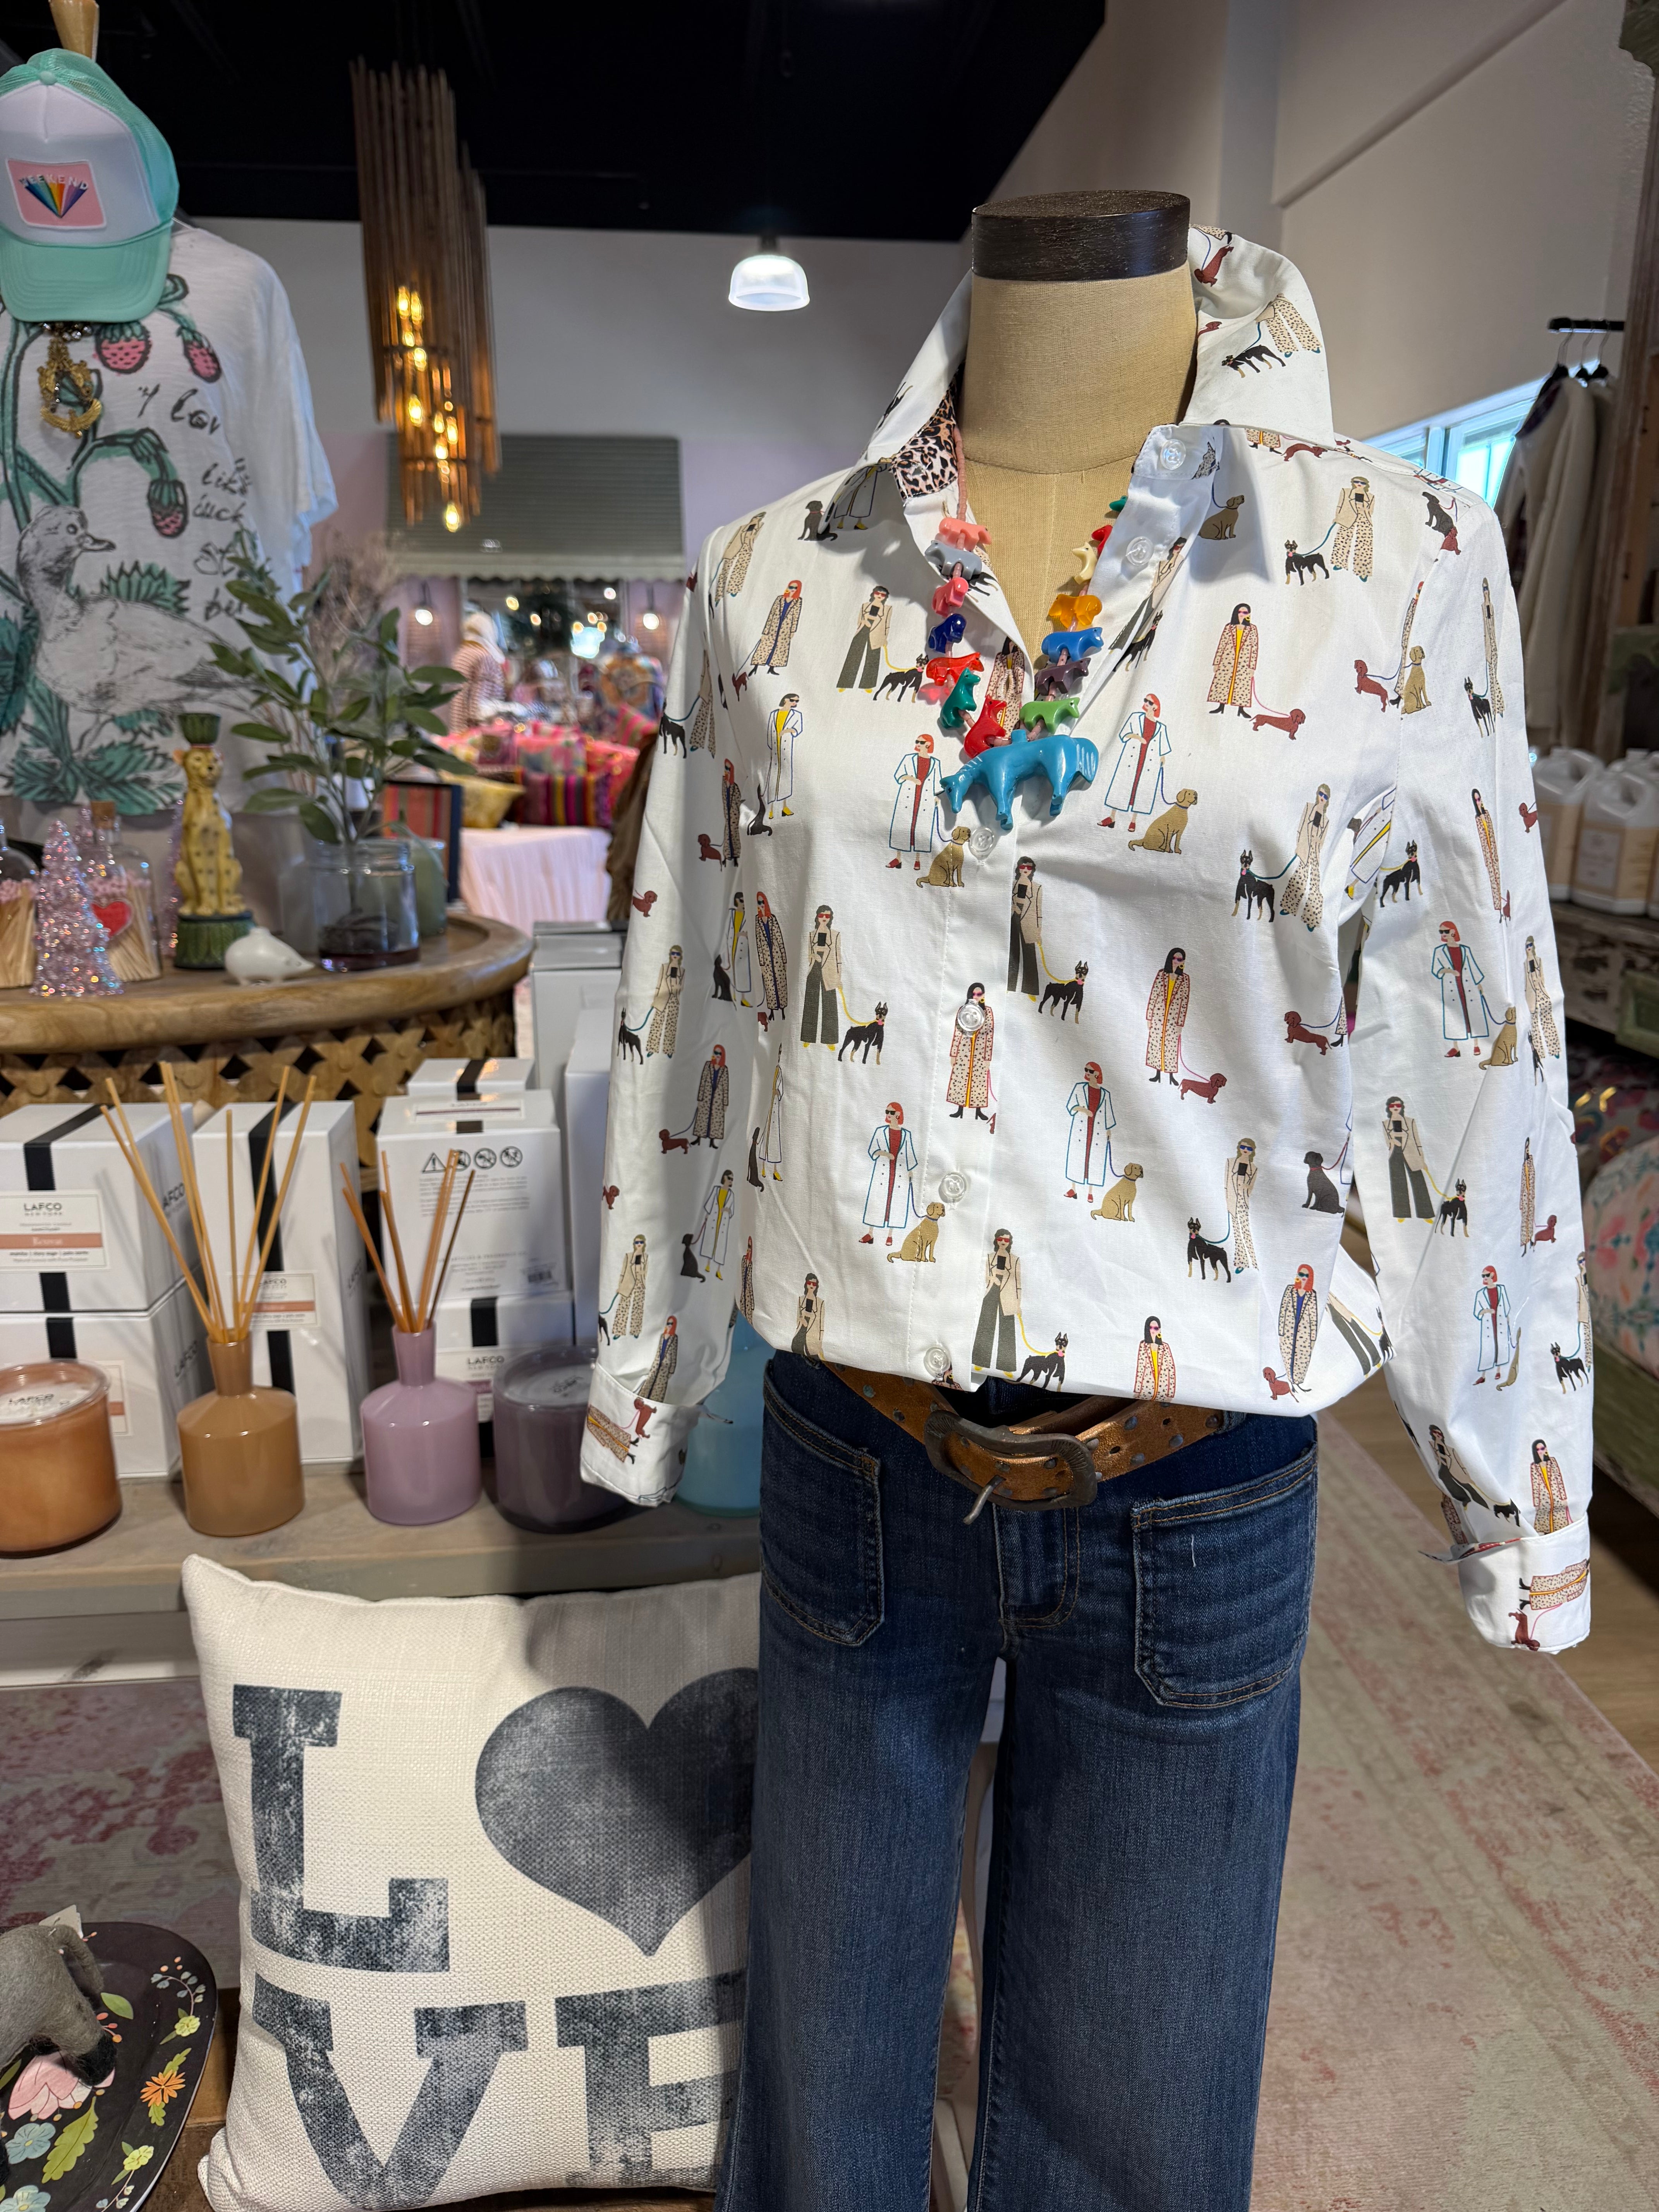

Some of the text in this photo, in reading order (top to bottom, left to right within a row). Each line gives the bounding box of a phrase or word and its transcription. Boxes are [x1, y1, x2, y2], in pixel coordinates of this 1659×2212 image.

[19, 174, 88, 190] WEEKEND
[24, 1202, 63, 1211] LAFCO
[467, 1355, 505, 1364] LAFCO
[232, 1683, 450, 1973] L
